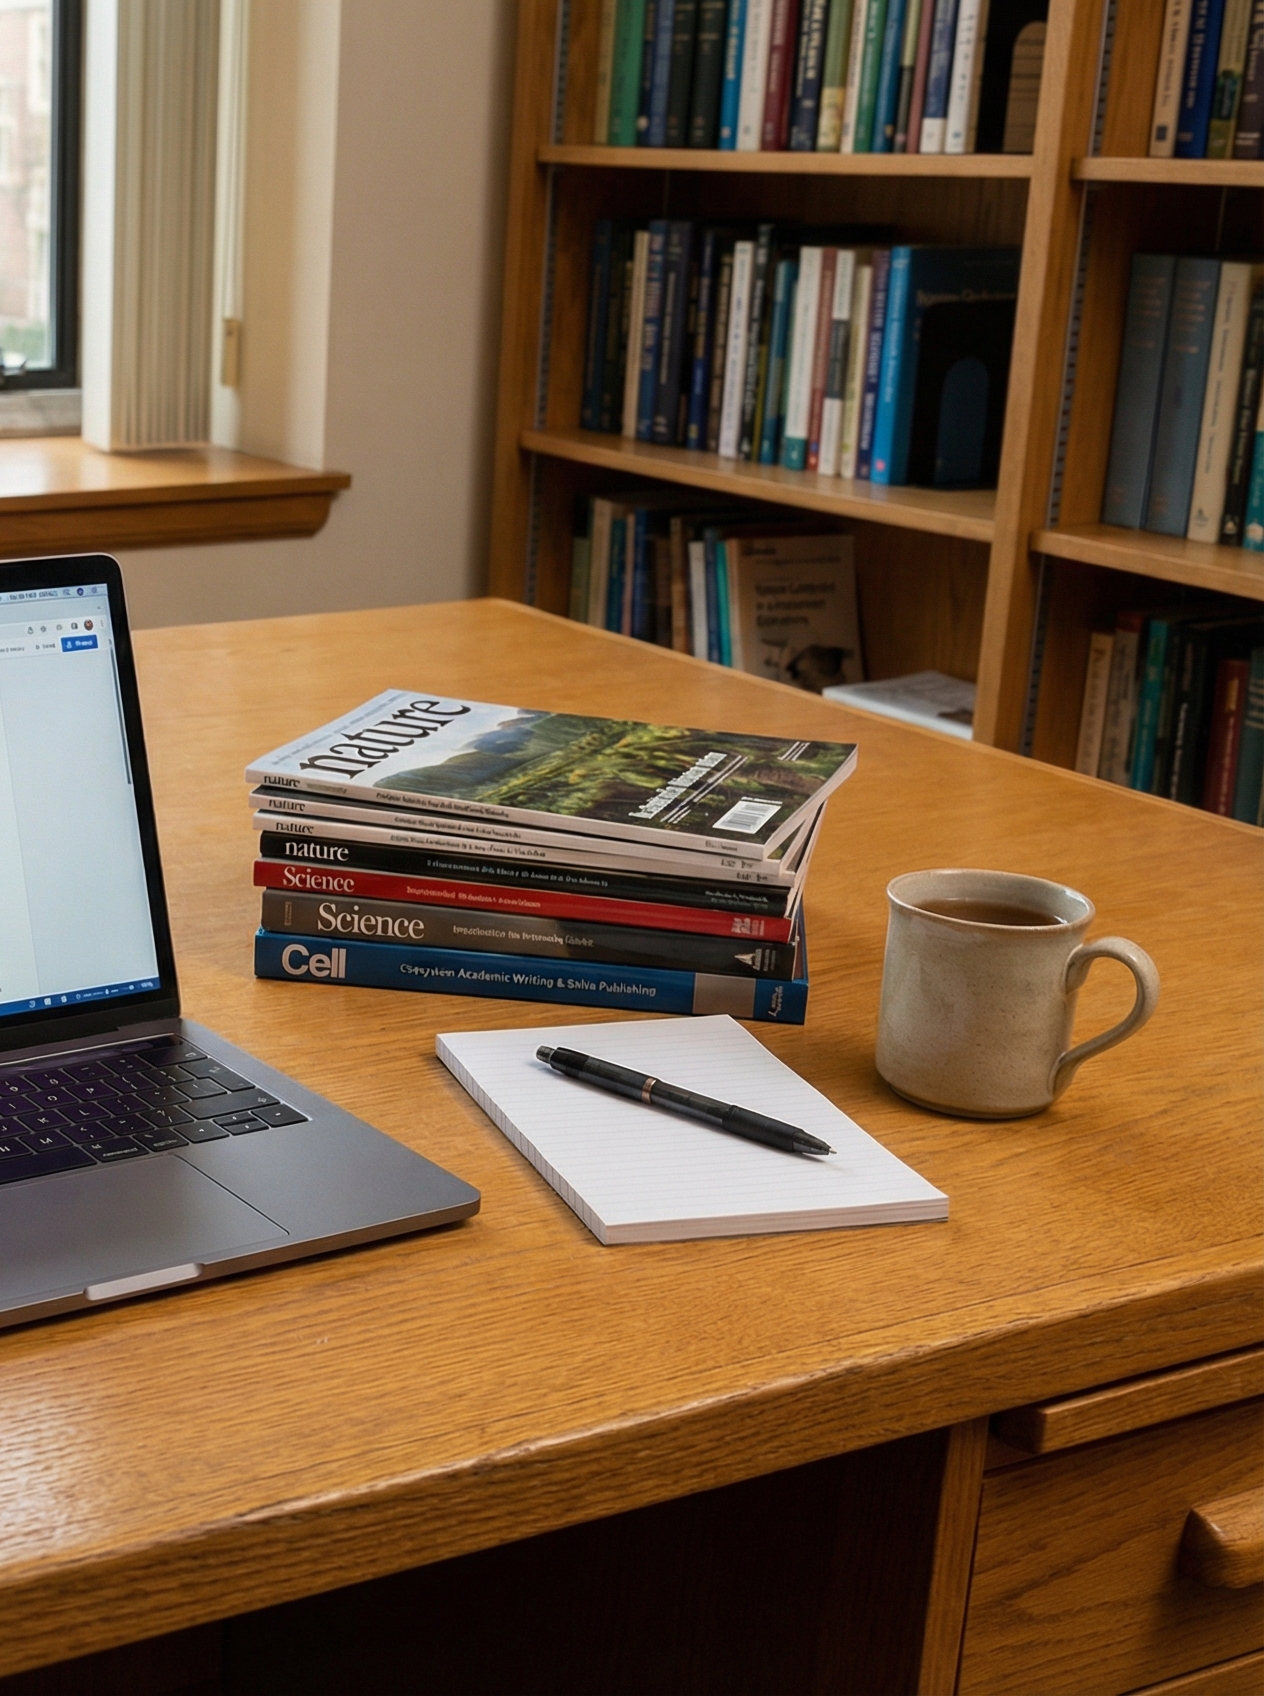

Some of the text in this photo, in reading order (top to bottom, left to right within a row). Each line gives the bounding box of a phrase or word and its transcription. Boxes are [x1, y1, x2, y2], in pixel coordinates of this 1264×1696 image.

[299, 699, 472, 780] nature
[285, 840, 350, 862] nature
[283, 866, 355, 893] Science
[317, 902, 425, 940] Science
[281, 943, 347, 980] Cell
[456, 968, 511, 984] Academic
[513, 972, 555, 990] Writing
